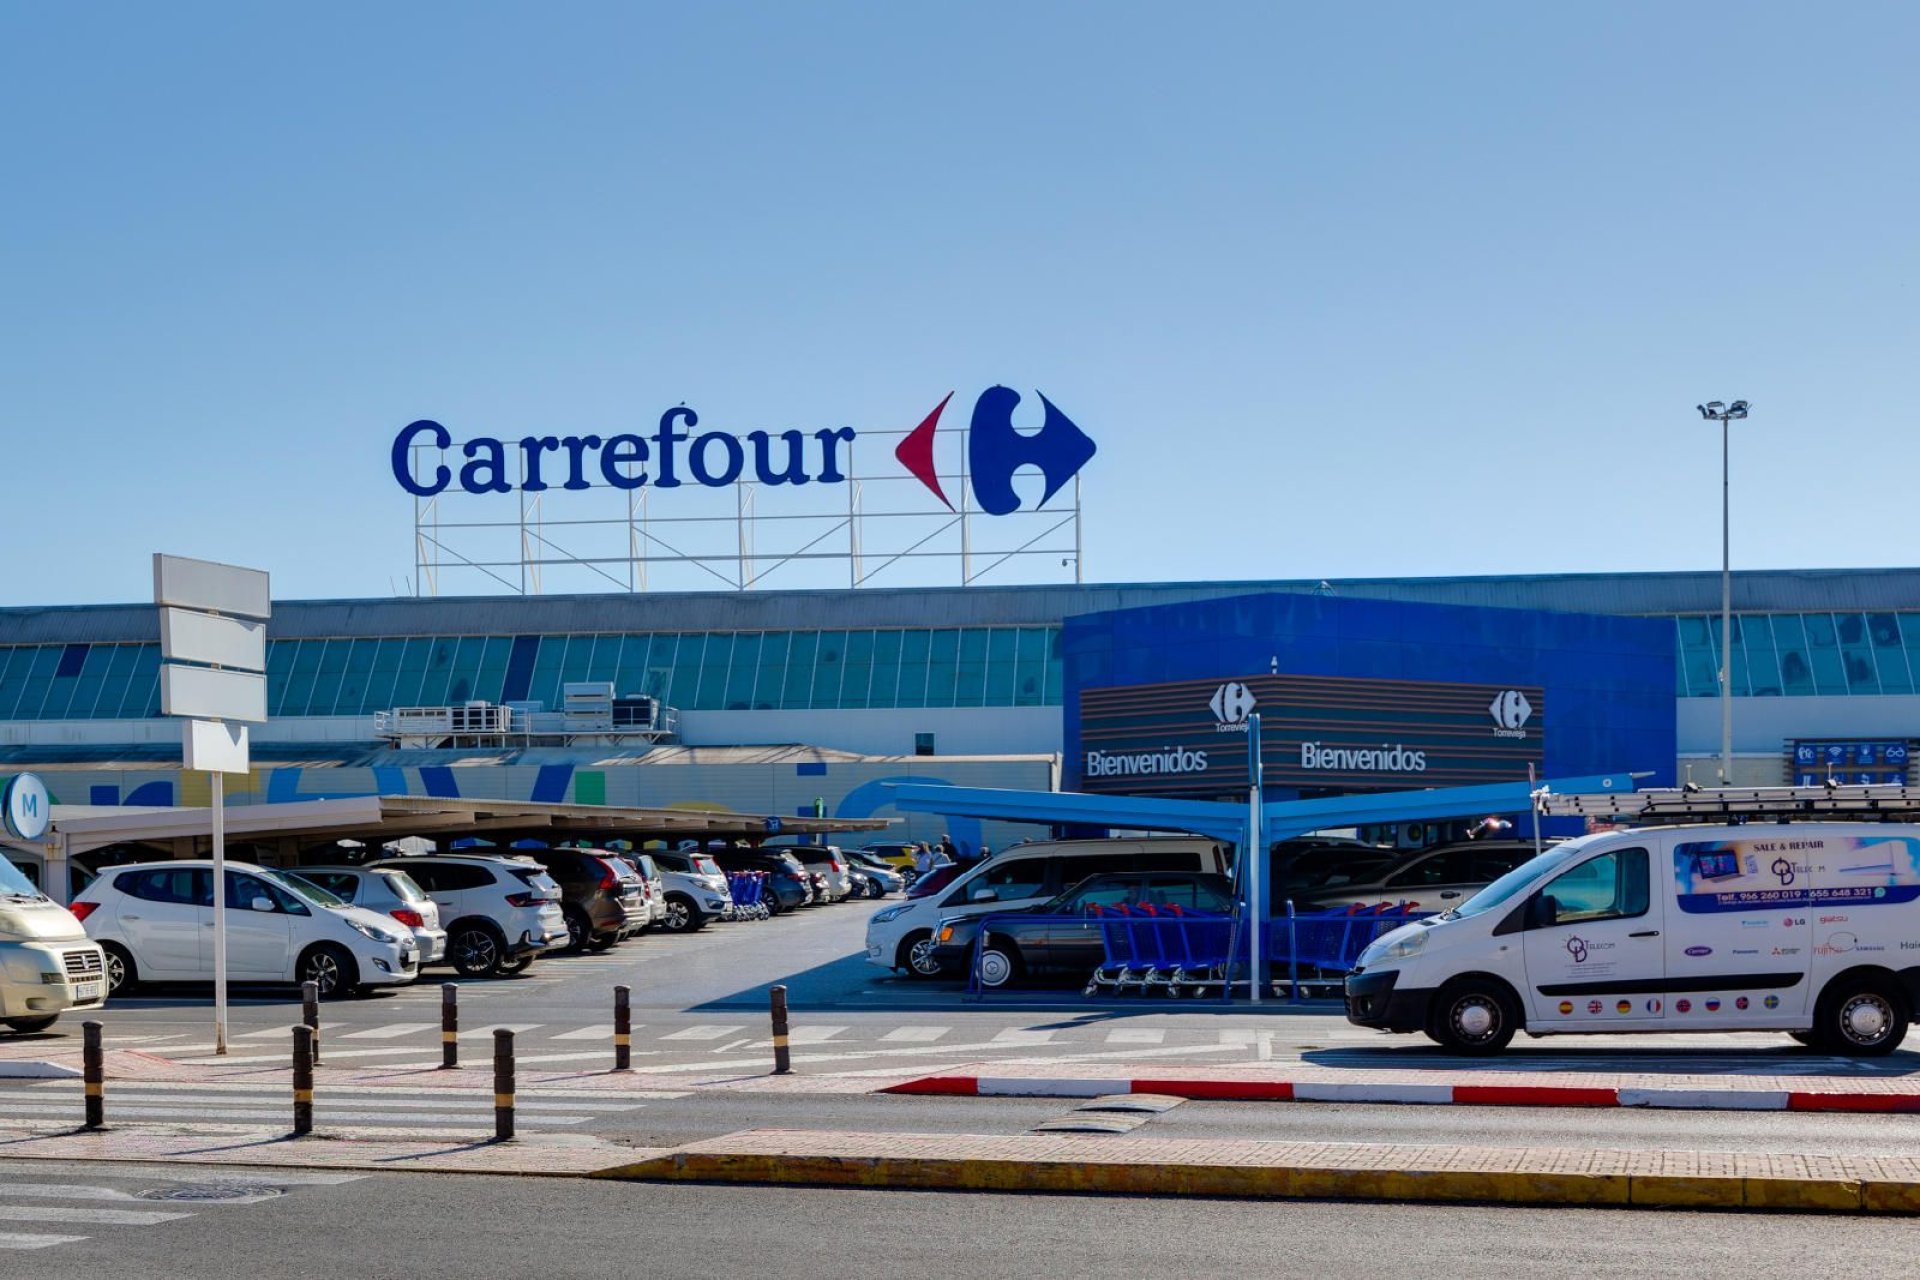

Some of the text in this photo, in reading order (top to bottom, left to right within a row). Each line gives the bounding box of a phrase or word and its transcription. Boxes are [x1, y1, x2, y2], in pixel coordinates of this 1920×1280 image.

[391, 406, 856, 497] Carrefour
[1215, 721, 1249, 733] Torreviej
[1493, 727, 1526, 740] Torrevieja
[1088, 746, 1208, 777] Bienvenidos
[1301, 741, 1426, 771] Bienvenidos
[22, 793, 37, 818] M
[1753, 840, 1824, 852] SALE & REPAIR
[1790, 862, 1826, 873] TELECM
[1760, 891, 1780, 900] 260
[1781, 890, 1801, 899] 019
[1809, 890, 1828, 899] 655
[1831, 889, 1851, 898] 648
[1853, 888, 1872, 897] 321
[1794, 918, 1806, 926] LG
